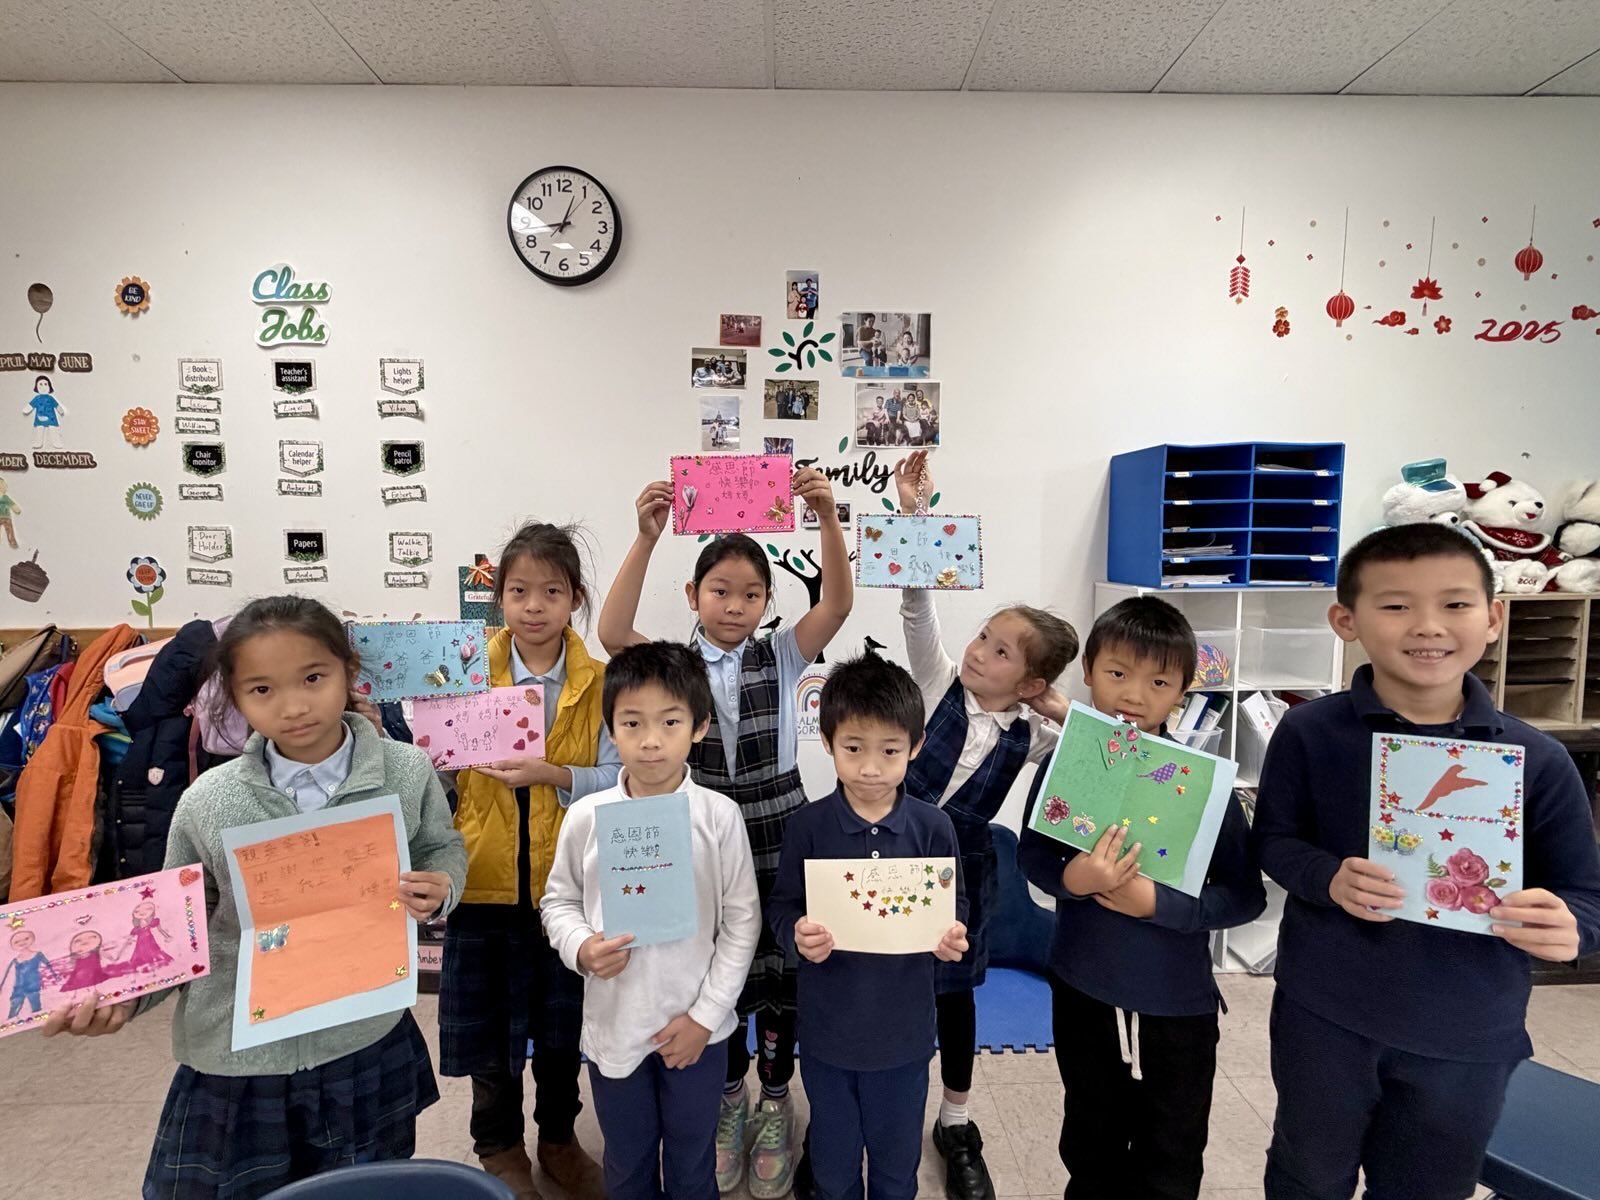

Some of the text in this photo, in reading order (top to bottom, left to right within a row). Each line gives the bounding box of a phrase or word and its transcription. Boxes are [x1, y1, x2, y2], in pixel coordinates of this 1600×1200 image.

[541, 183, 552, 197] 11
[556, 179, 572, 193] 12
[582, 185, 587, 199] 1
[526, 197, 543, 210] 10
[591, 201, 603, 214] 2
[520, 216, 531, 230] 9
[597, 220, 608, 234] 3
[526, 235, 537, 248] 8
[590, 239, 602, 252] 4
[540, 251, 551, 264] 7
[579, 252, 590, 266] 5
[558, 258, 569, 271] 6
[252, 266, 329, 300] Class
[128, 286, 139, 295] BE
[124, 295, 142, 303] KIND
[259, 307, 326, 342] Jobs
[1474, 319, 1565, 343] 2025
[0, 356, 25, 368] PRIL
[29, 356, 53, 368] MAY
[61, 356, 89, 368] JUNE
[192, 365, 208, 373] Book
[280, 367, 308, 376] Teacher's
[393, 367, 412, 376] Lights
[184, 374, 217, 382] distributor
[393, 376, 412, 385] helper
[130, 426, 150, 434] SWEET
[35, 454, 95, 466] DECEMBER
[288, 450, 315, 458] Calendar
[393, 450, 412, 458] Pencil
[192, 458, 217, 466] monitor
[292, 458, 312, 466] helper
[394, 458, 412, 466] patrol
[293, 539, 318, 549] Papers
[397, 548, 420, 556] Talkie
[797, 716, 820, 726] ALM
[611, 825, 660, 844] 感恩節
